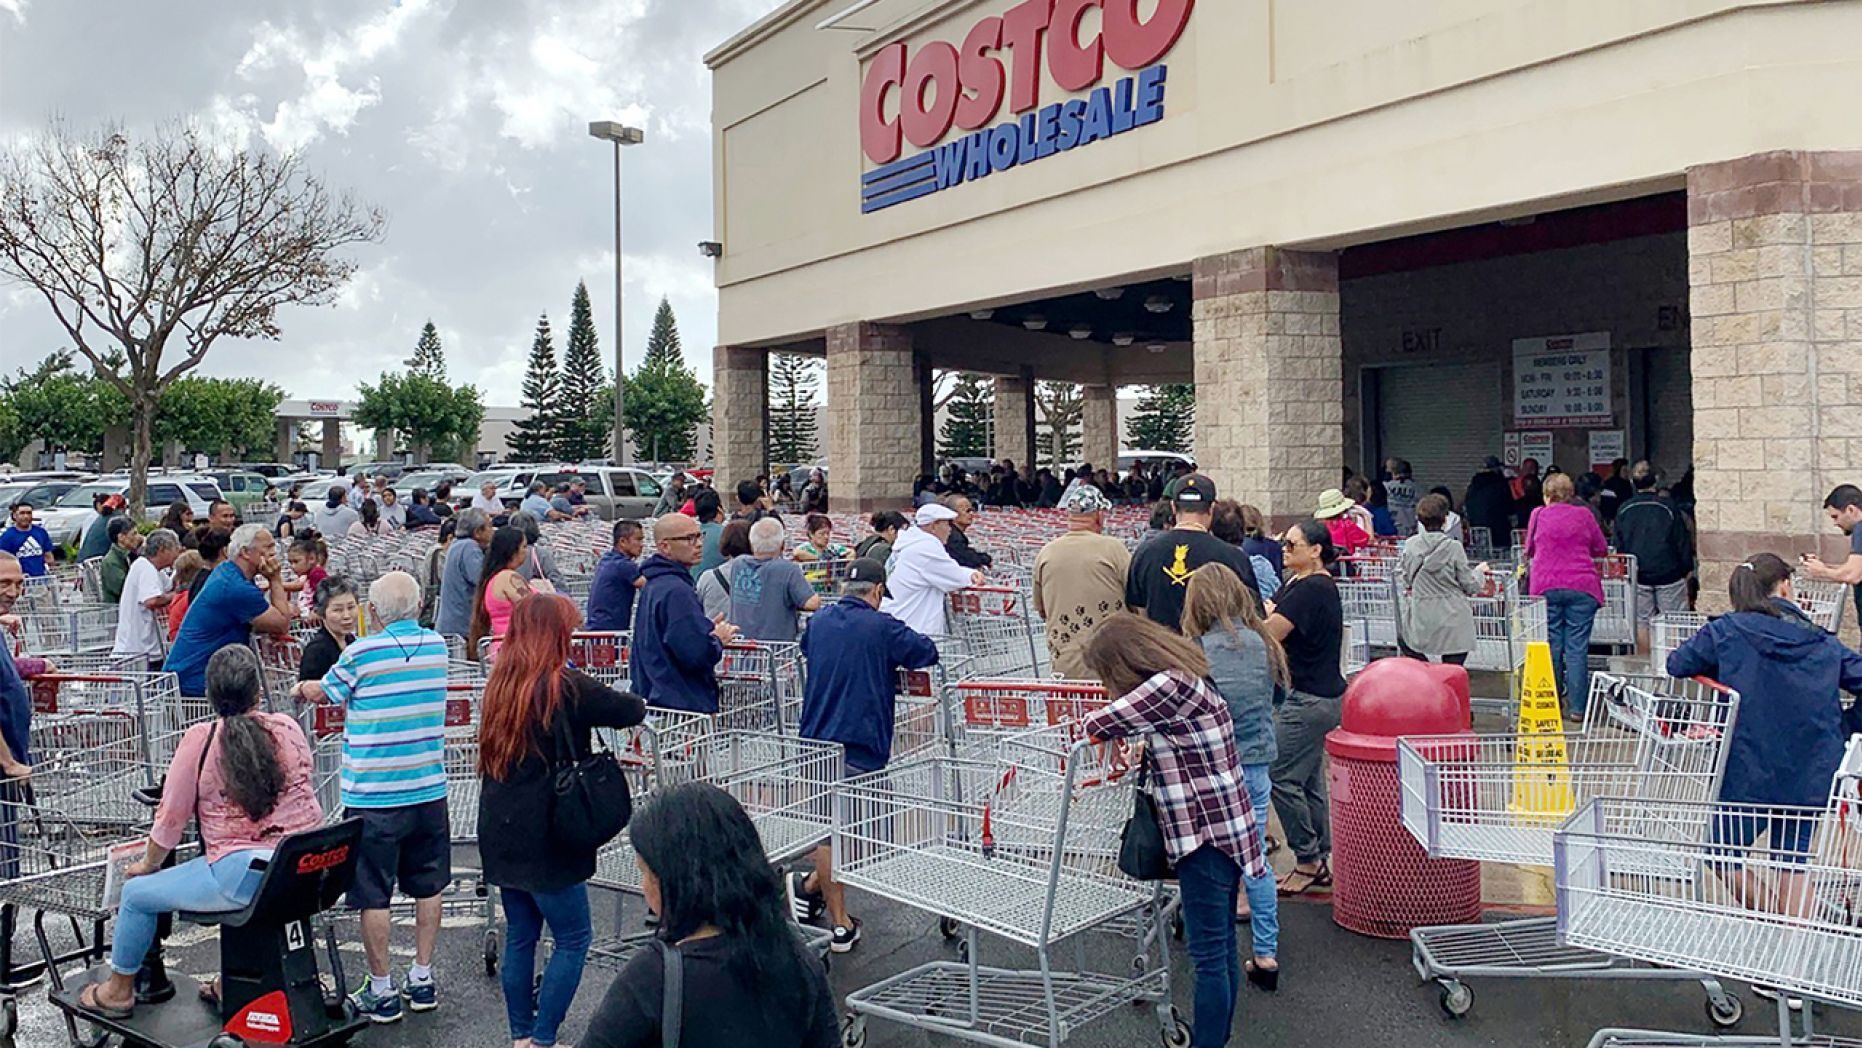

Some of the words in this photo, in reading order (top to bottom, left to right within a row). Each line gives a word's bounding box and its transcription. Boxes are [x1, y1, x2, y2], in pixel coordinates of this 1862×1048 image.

[860, 0, 1197, 164] COSTCO
[934, 65, 1167, 190] WHOLESALE
[1402, 328, 1442, 352] EXIT
[1535, 719, 1558, 728] SAFETY
[290, 923, 301, 945] 4
